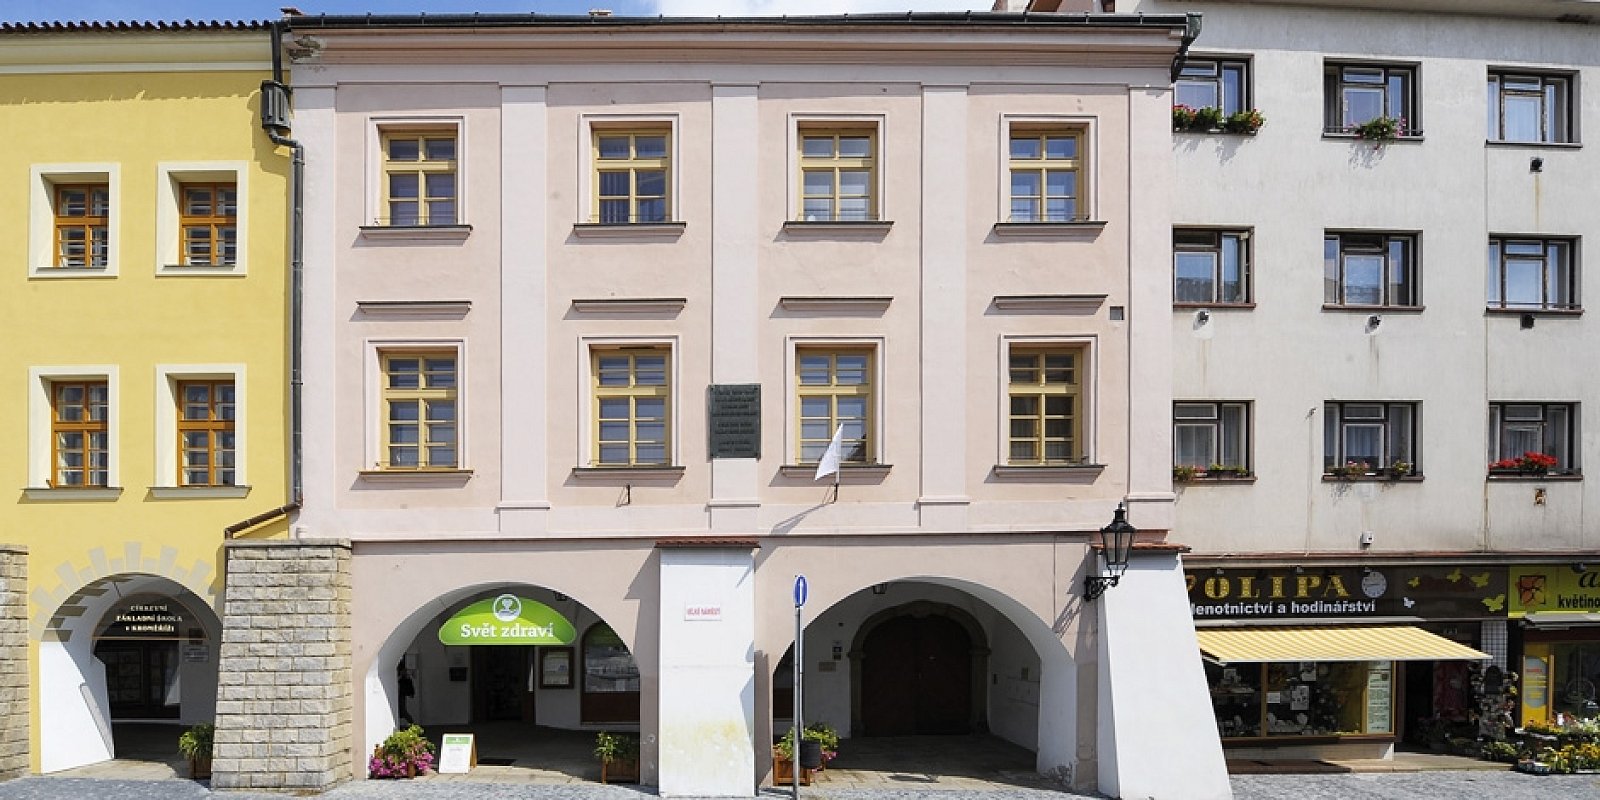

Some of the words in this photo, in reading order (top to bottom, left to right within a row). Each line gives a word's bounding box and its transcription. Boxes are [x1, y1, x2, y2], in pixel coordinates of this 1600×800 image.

[1190, 600, 1273, 615] lenotnictví
[1277, 603, 1286, 614] a
[1291, 599, 1376, 614] hodinářství
[460, 622, 497, 638] Svět
[501, 622, 554, 638] zdraví
